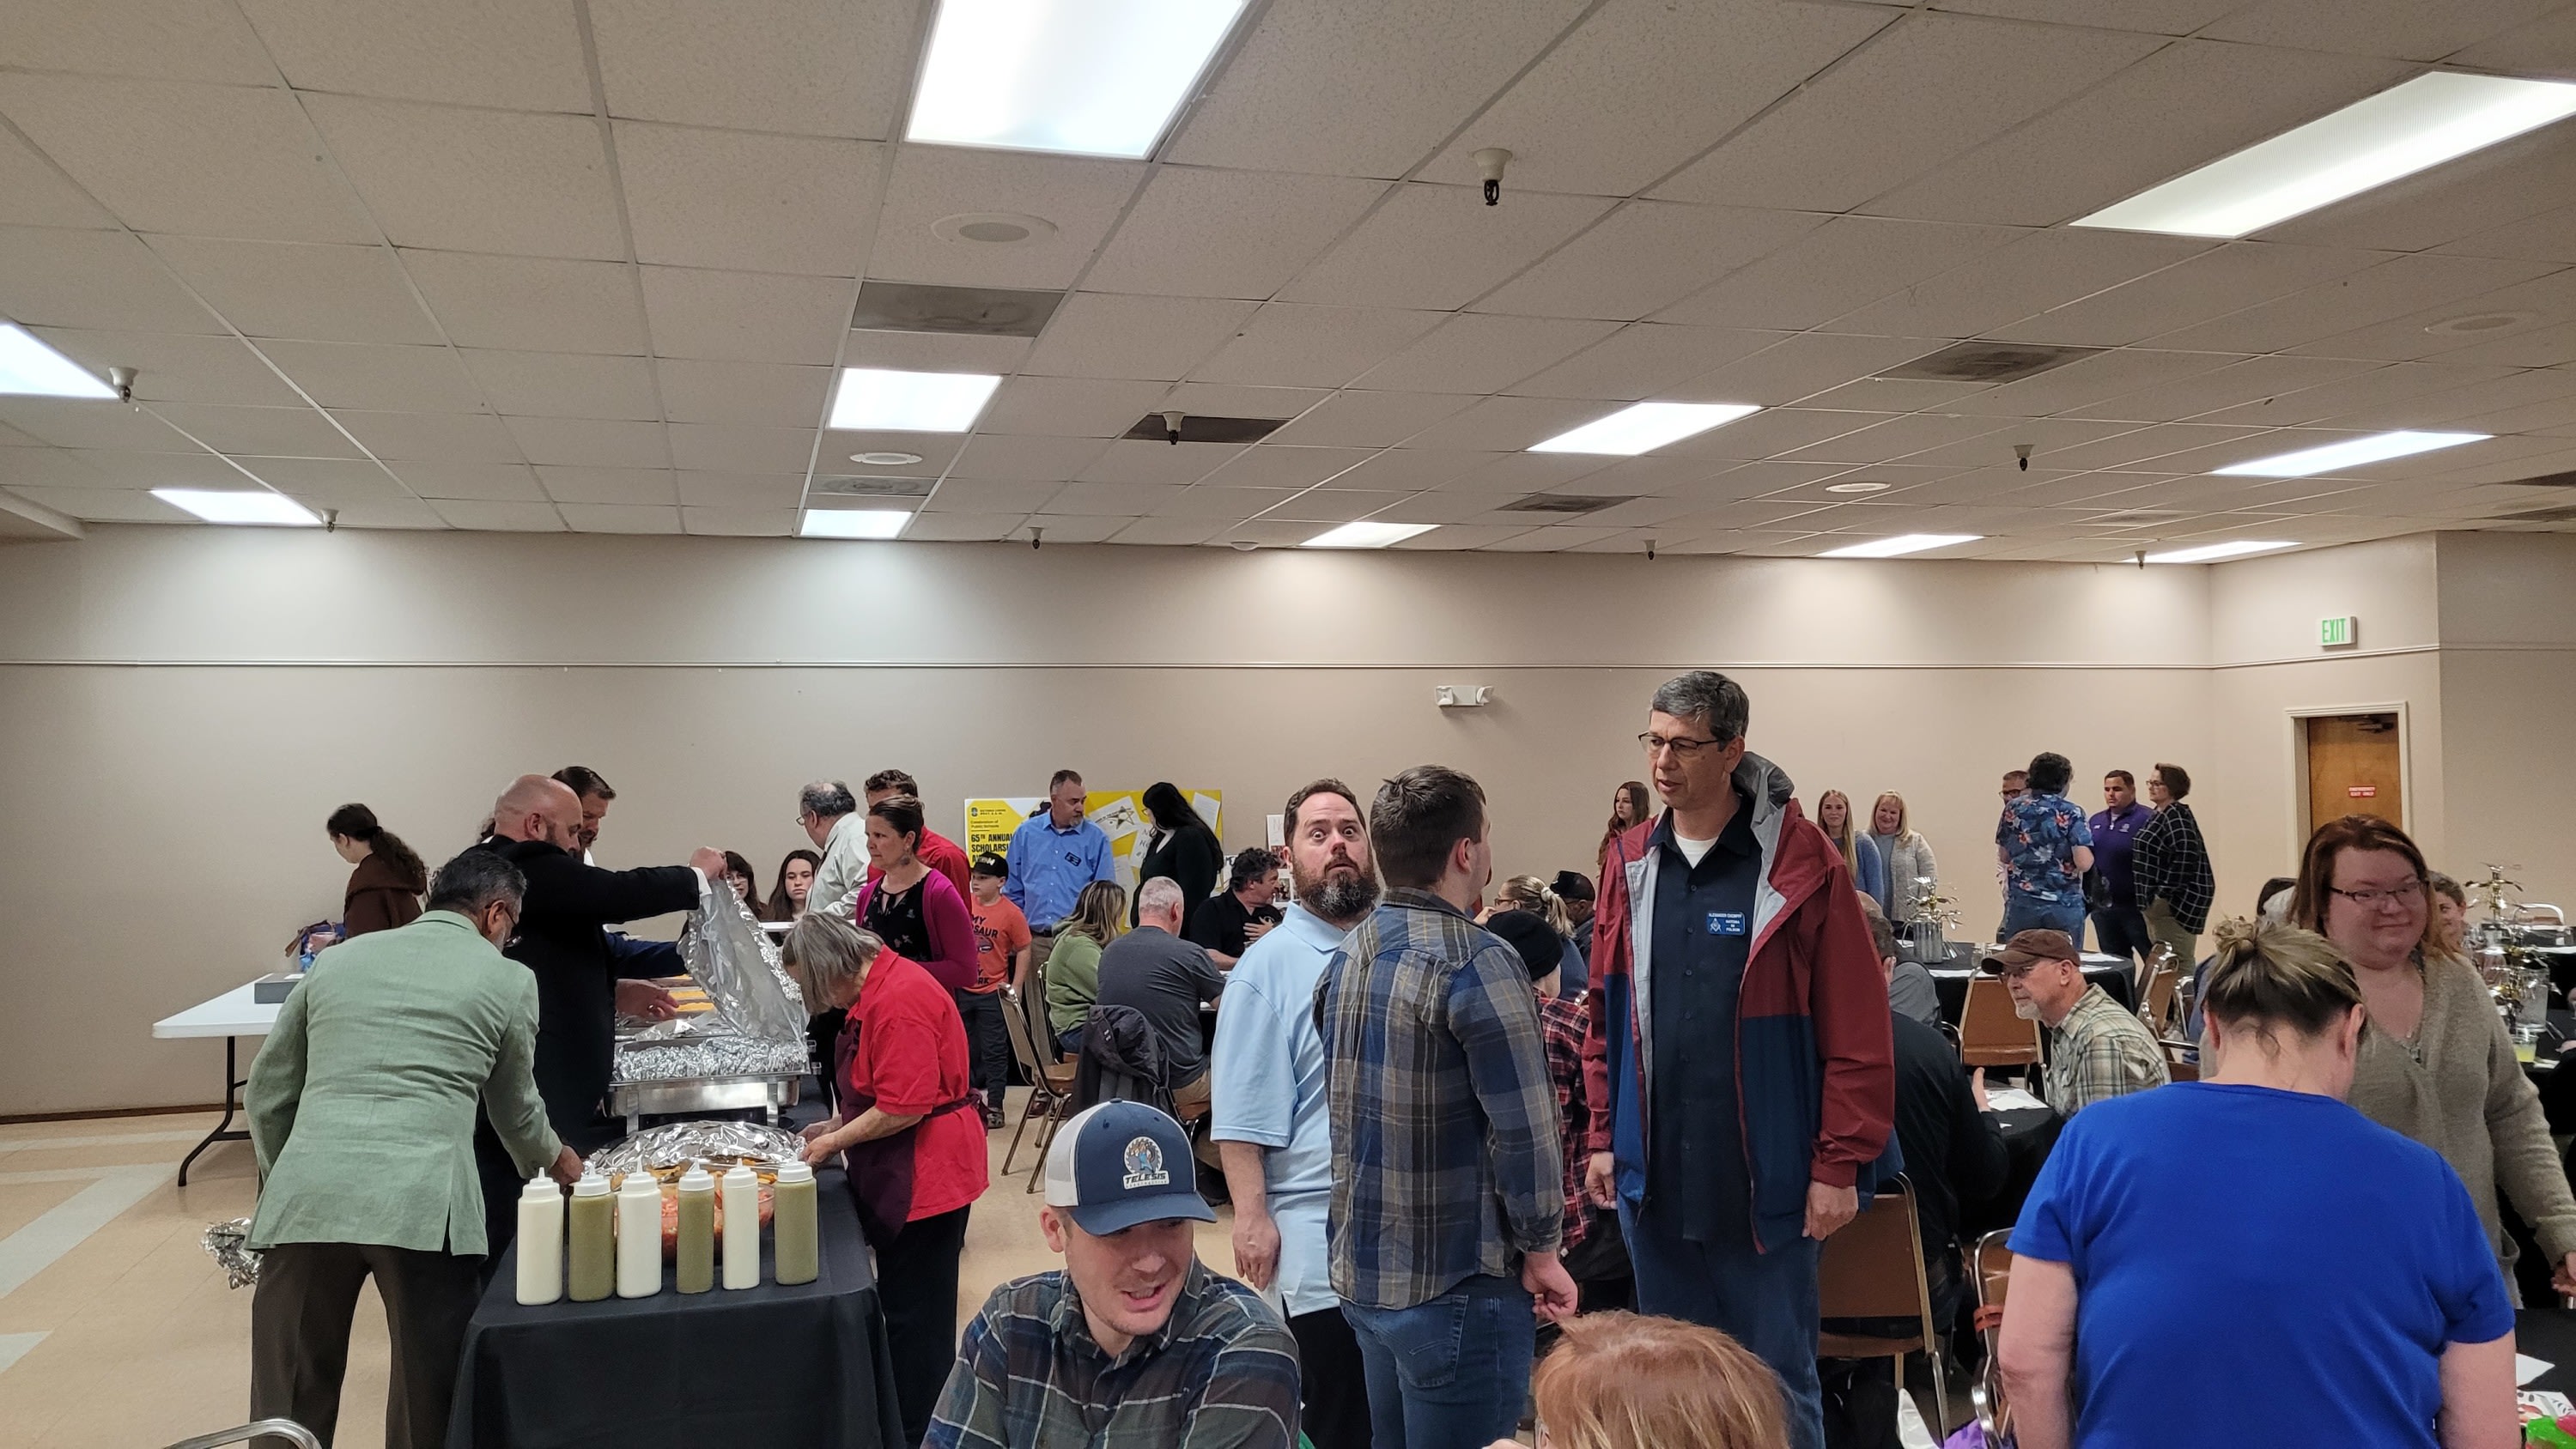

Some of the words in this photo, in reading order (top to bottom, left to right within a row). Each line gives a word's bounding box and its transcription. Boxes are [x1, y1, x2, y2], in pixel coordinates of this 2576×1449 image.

[2322, 618, 2346, 643] EXIT
[971, 834, 986, 842] 65TH
[971, 915, 986, 925] MY
[972, 925, 998, 938] SAUR
[1125, 1173, 1166, 1185] TELESIS
